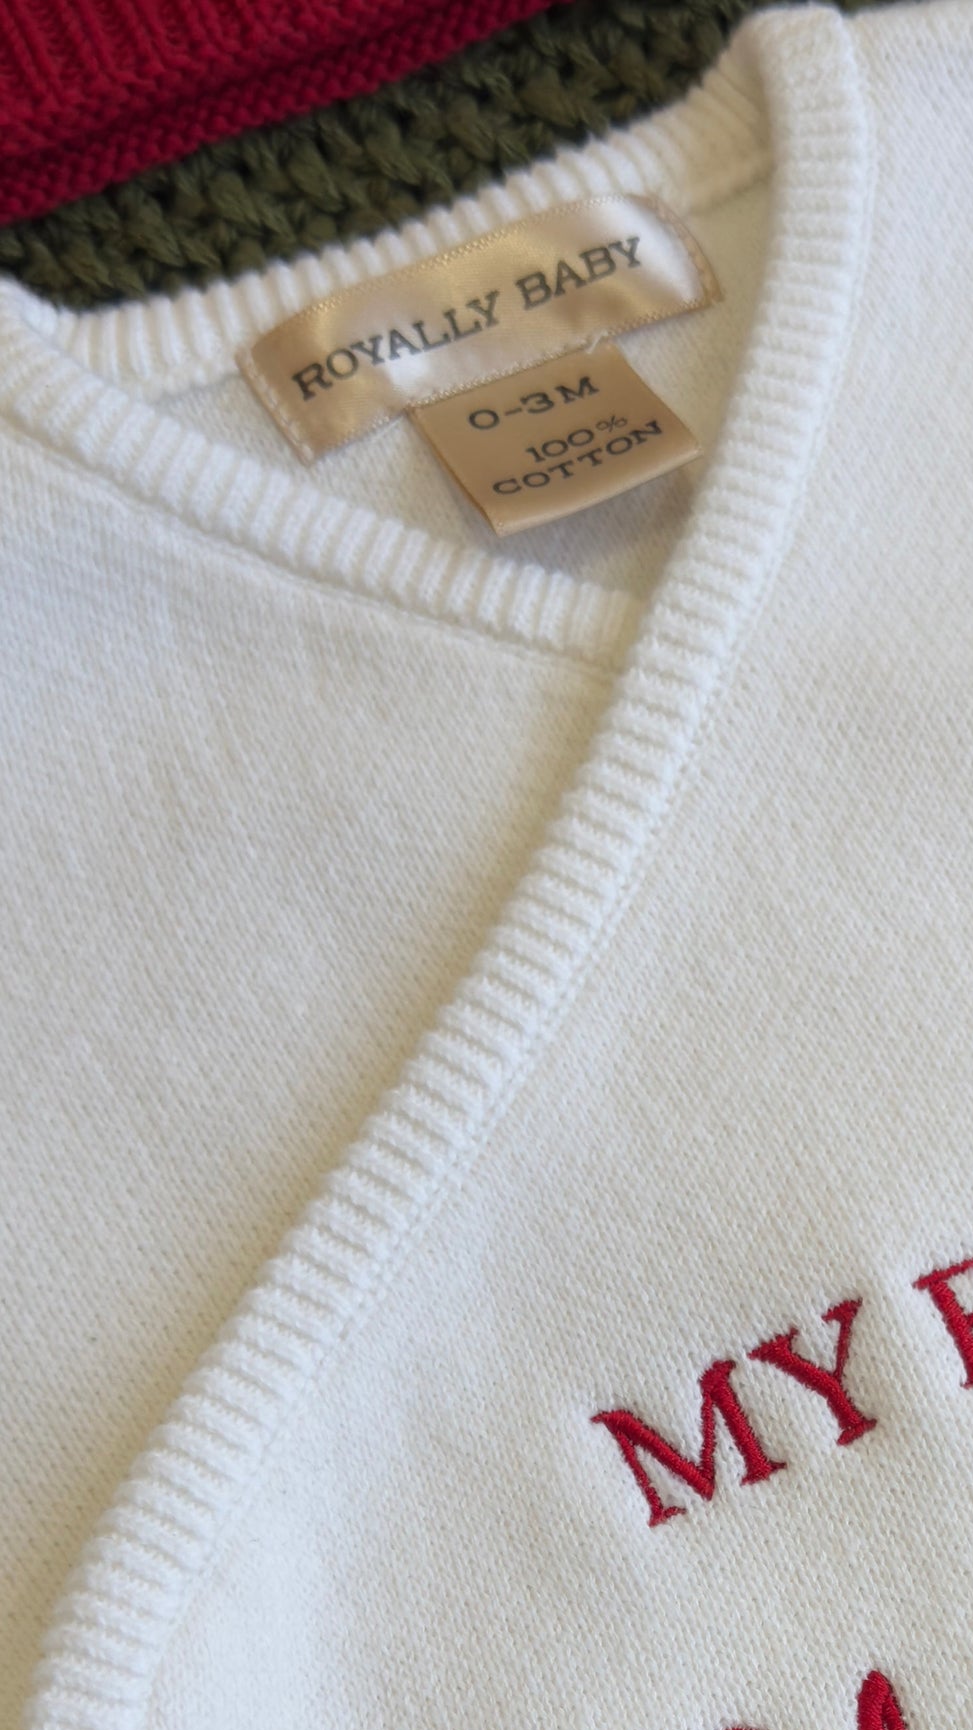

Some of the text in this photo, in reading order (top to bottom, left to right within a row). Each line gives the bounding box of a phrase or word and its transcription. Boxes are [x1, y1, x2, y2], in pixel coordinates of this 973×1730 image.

[292, 235, 642, 401] ROYALLY BABY
[467, 375, 600, 431] 0-3M
[525, 414, 628, 464] 100%
[491, 419, 663, 496] COTTON
[592, 1300, 877, 1526] MY
